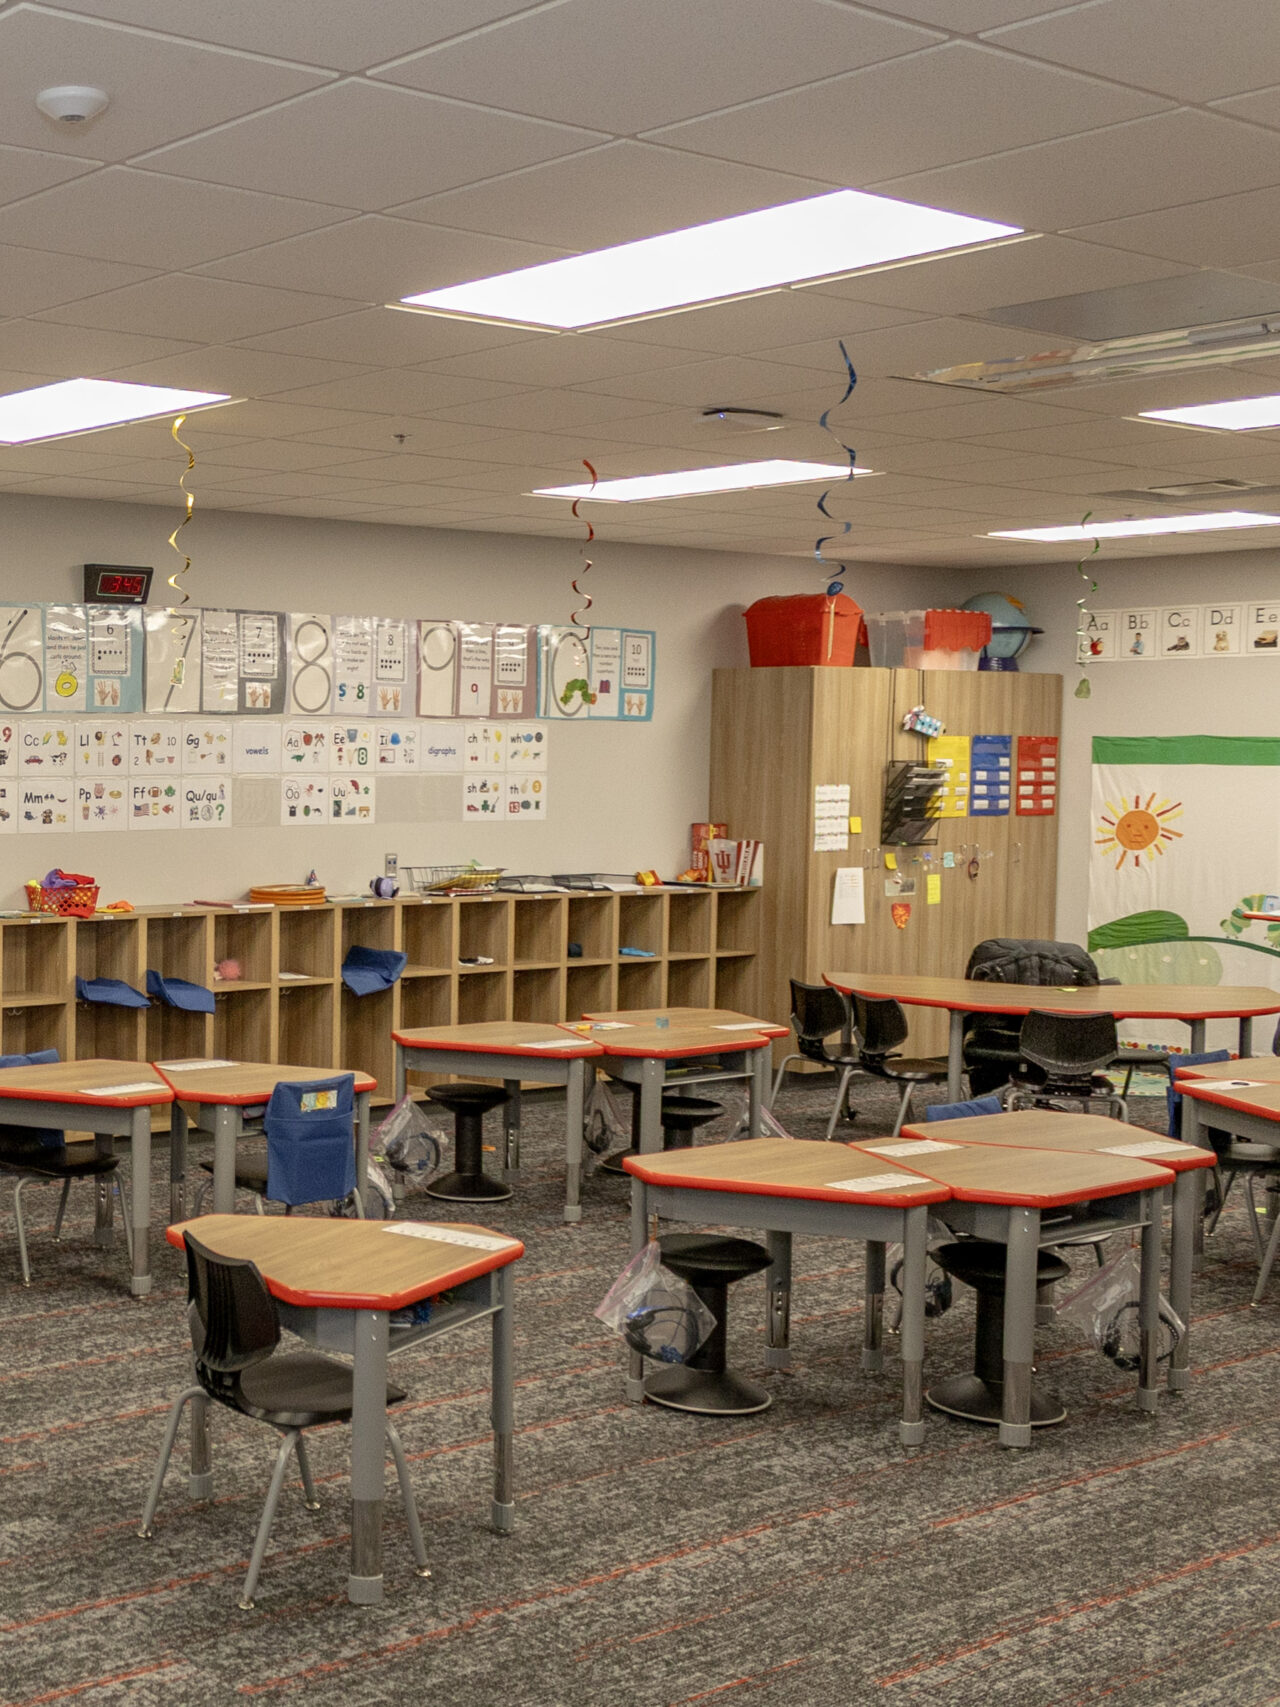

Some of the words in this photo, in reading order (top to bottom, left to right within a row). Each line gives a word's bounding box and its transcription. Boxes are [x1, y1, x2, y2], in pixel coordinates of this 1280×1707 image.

[1168, 612, 1191, 628] Cc
[1210, 610, 1233, 625] Dd
[1255, 607, 1278, 623] Ee
[1128, 614, 1150, 630] Bb
[256, 626, 262, 639] 7
[388, 634, 393, 646] 8
[631, 644, 641, 655] 10
[293, 620, 331, 713] 8
[422, 625, 456, 716] 9
[2, 726, 12, 743] 9
[24, 734, 40, 746] Cc
[134, 734, 147, 746] Tt
[334, 732, 345, 745] Ee
[467, 734, 478, 743] ch
[510, 734, 522, 743] wh
[167, 736, 177, 746] 10
[186, 734, 200, 748] Gg
[287, 739, 299, 748] Aa
[245, 747, 269, 756] vowels
[134, 757, 140, 766] 2
[133, 787, 146, 799] Ff
[333, 786, 346, 798] Uu
[467, 783, 478, 793] sh
[509, 785, 519, 794] th
[24, 792, 44, 804] Mm
[79, 787, 92, 805] Pp
[186, 790, 217, 806] Qu/qu
